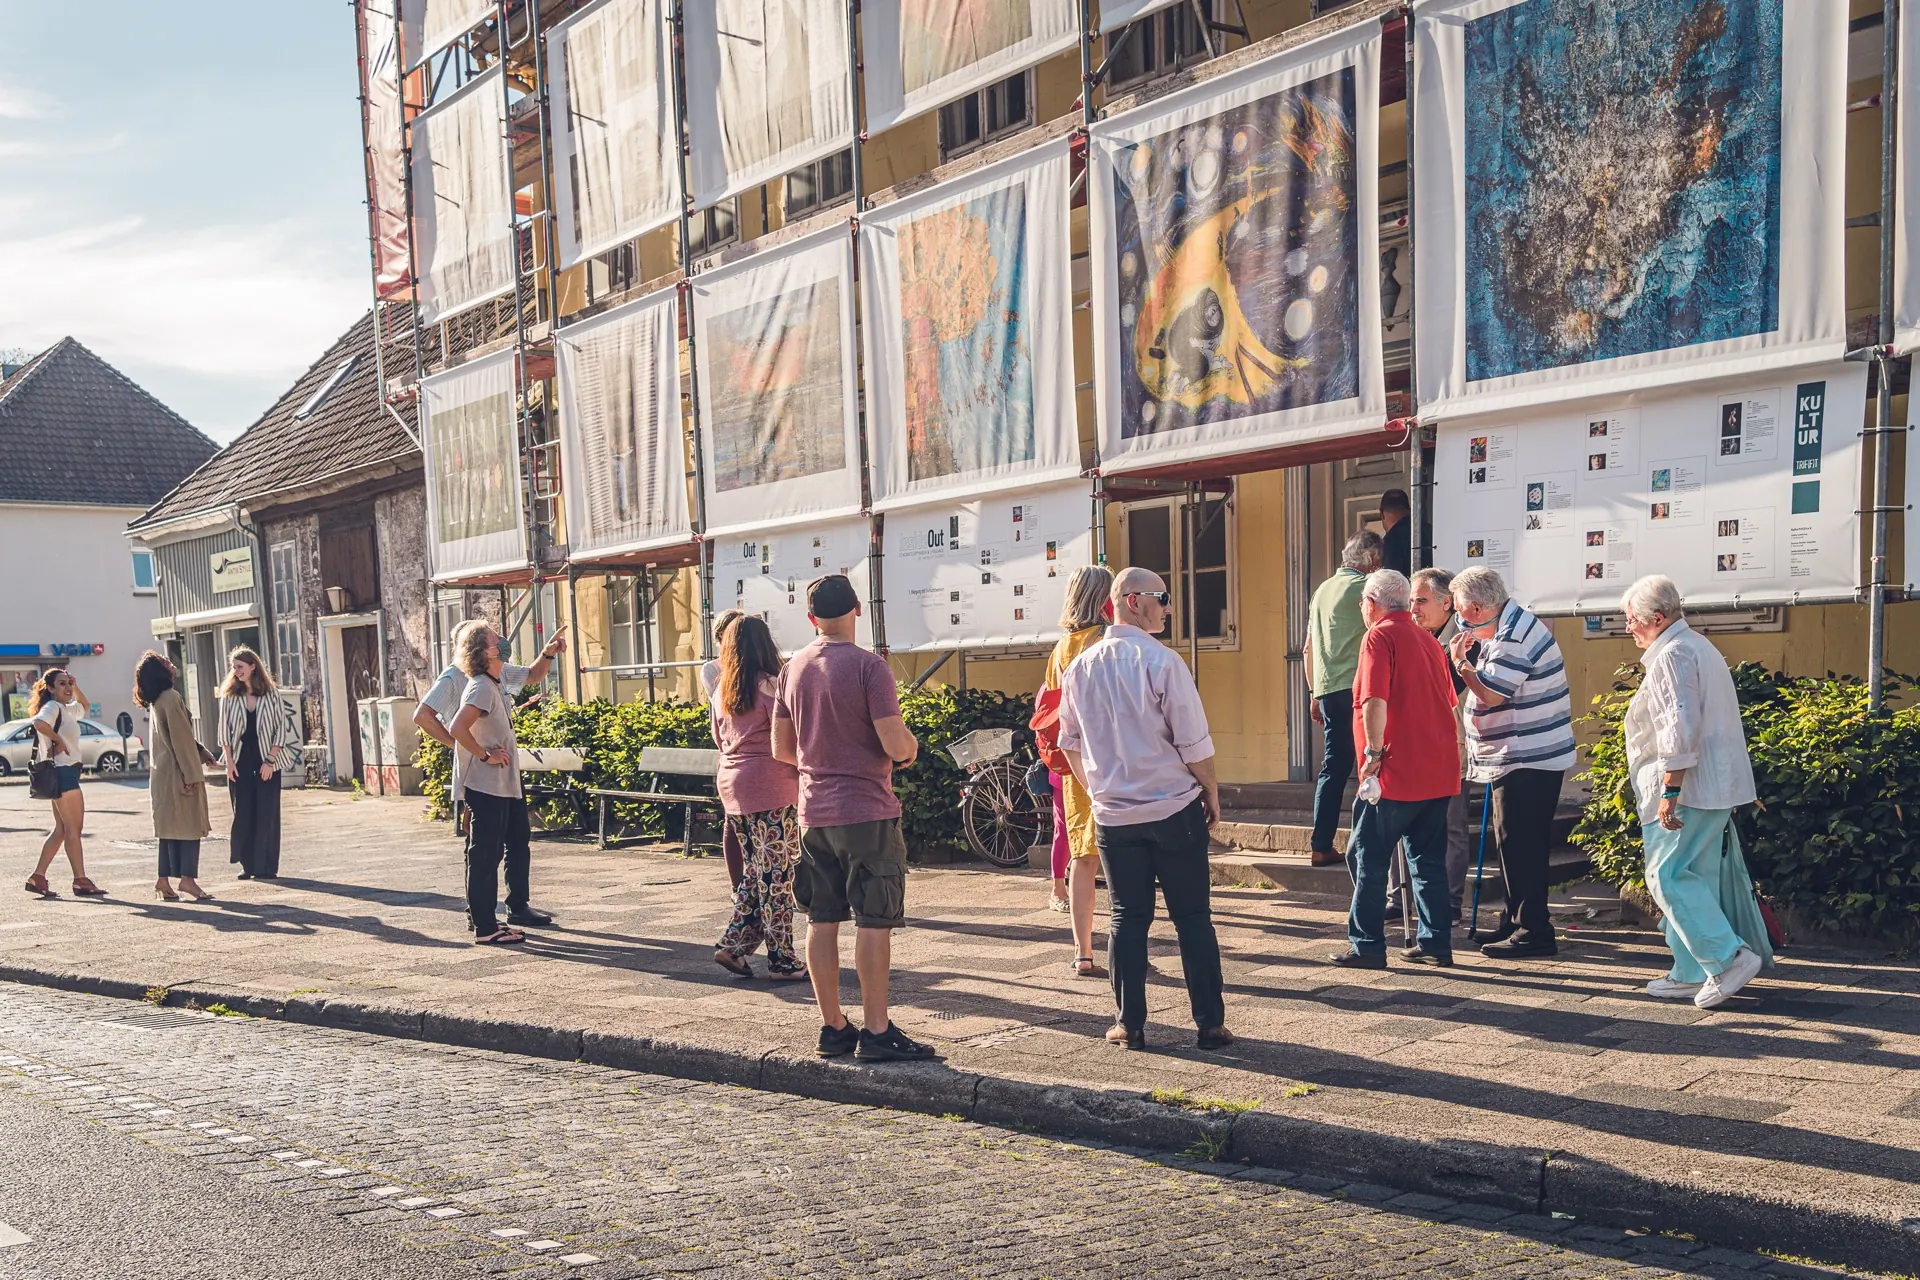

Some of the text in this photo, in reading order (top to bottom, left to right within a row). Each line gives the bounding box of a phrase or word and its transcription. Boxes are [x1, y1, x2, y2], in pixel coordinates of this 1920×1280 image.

[1800, 395, 1821, 411] KU
[1799, 412, 1820, 428] LT
[1798, 429, 1819, 445] UR
[50, 643, 91, 656] VGH
